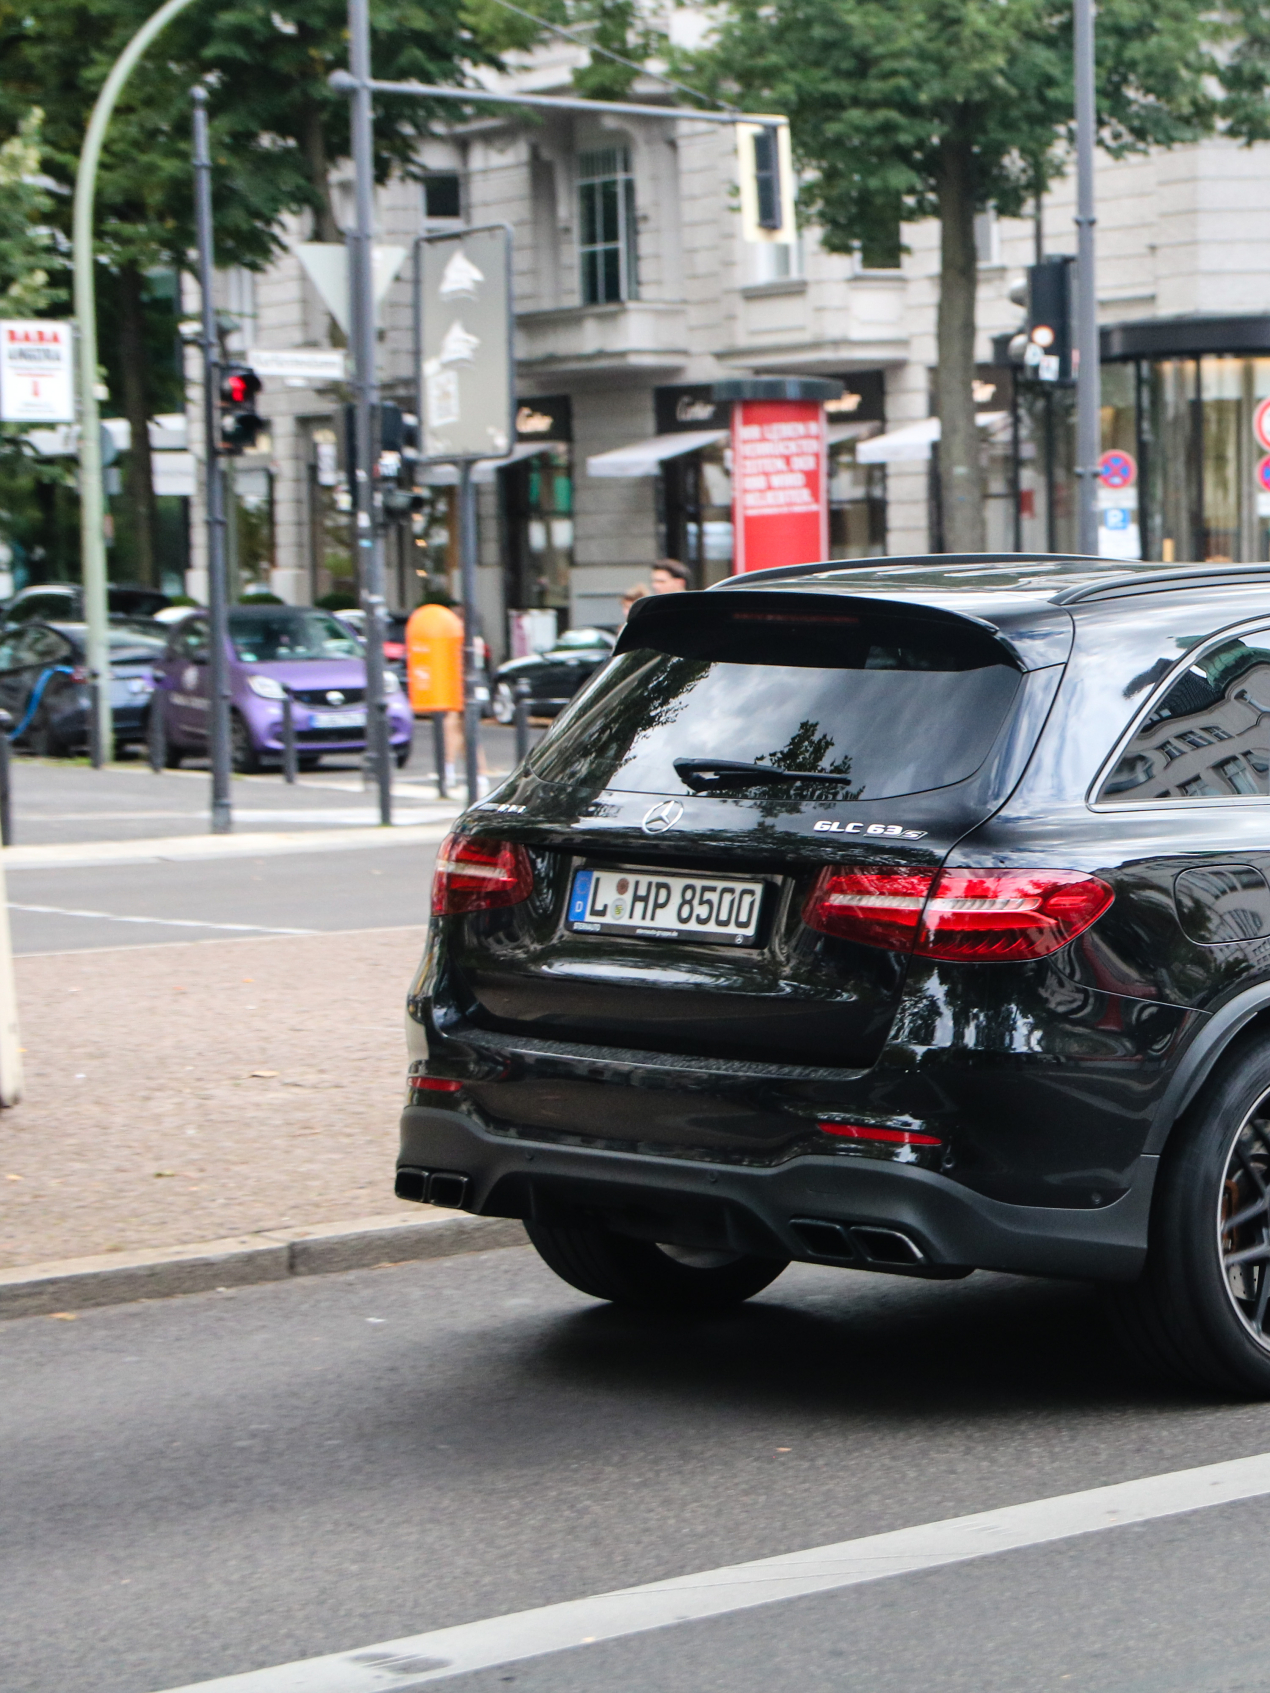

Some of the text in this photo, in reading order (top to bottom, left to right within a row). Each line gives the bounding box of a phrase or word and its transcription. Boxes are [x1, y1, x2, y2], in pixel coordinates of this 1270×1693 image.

[813, 820, 864, 835] GLC
[866, 823, 903, 837] 63
[574, 900, 584, 913] D
[589, 876, 757, 930] L HP 8500
